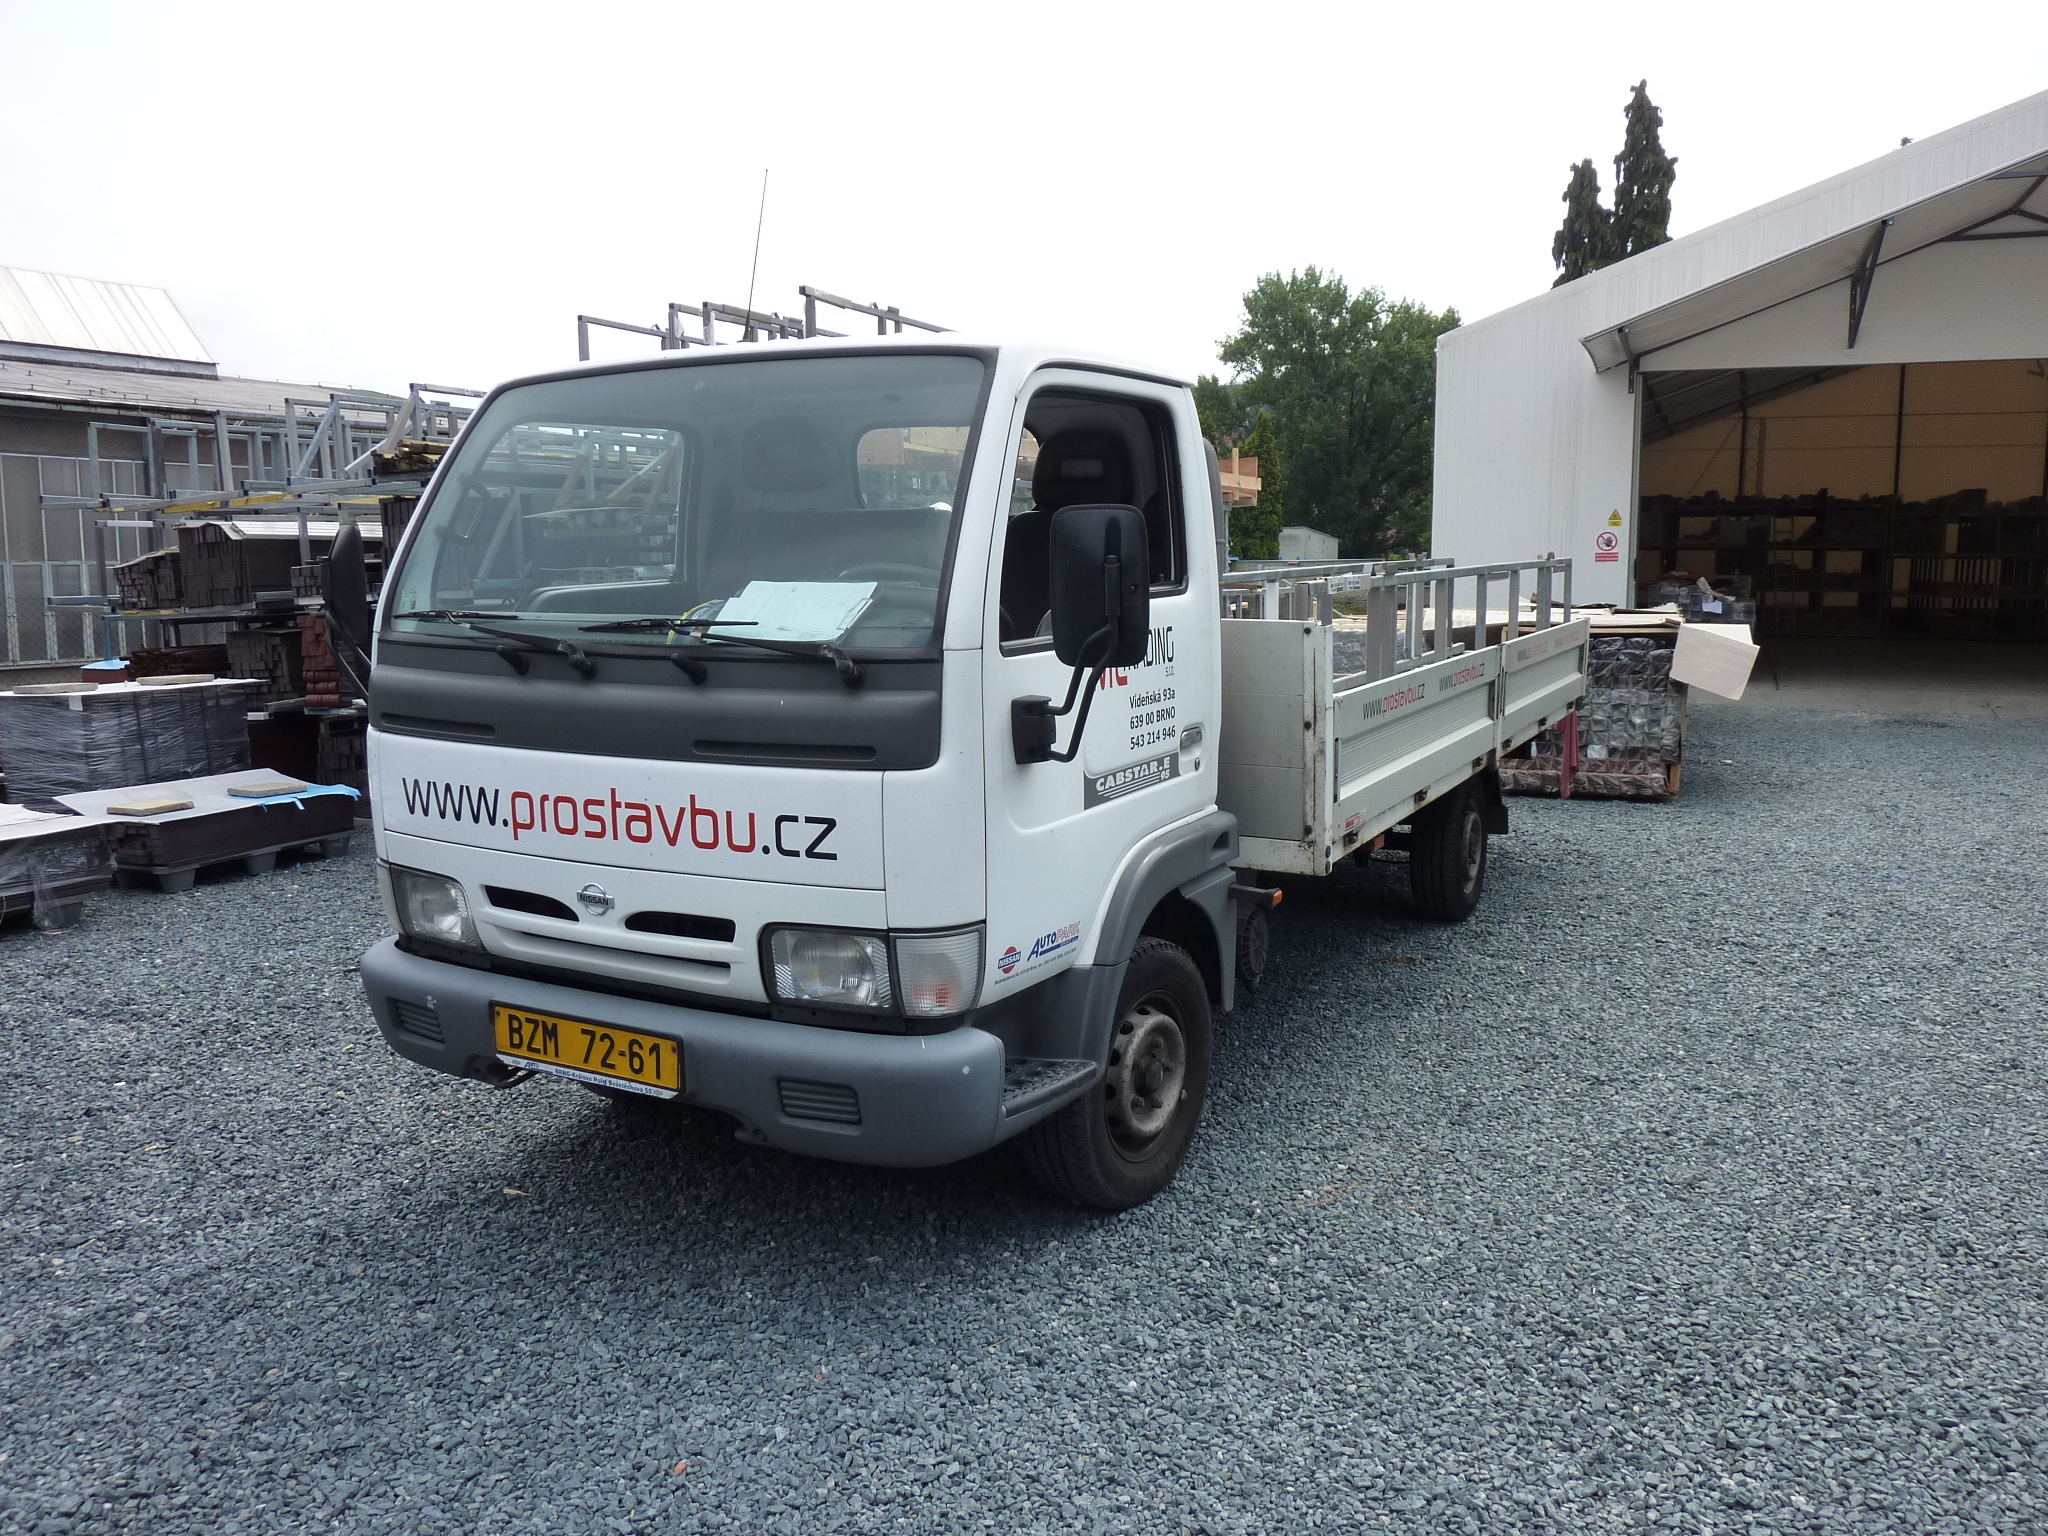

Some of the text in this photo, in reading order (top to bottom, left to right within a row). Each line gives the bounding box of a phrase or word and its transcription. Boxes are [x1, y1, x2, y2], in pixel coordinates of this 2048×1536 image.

[1129, 688, 1176, 709] Vídeňská 93a
[1363, 683, 1425, 720] www.prostavbu.cz
[1130, 706, 1176, 730] 639 00 BRNO
[1130, 725, 1176, 750] 543 214 946
[1160, 768, 1170, 781] 95
[402, 777, 838, 861] www.prostavbu.cz
[580, 894, 609, 906] NISSAN
[999, 951, 1021, 968] NISSAN
[508, 1013, 662, 1081] BZM 72-61
